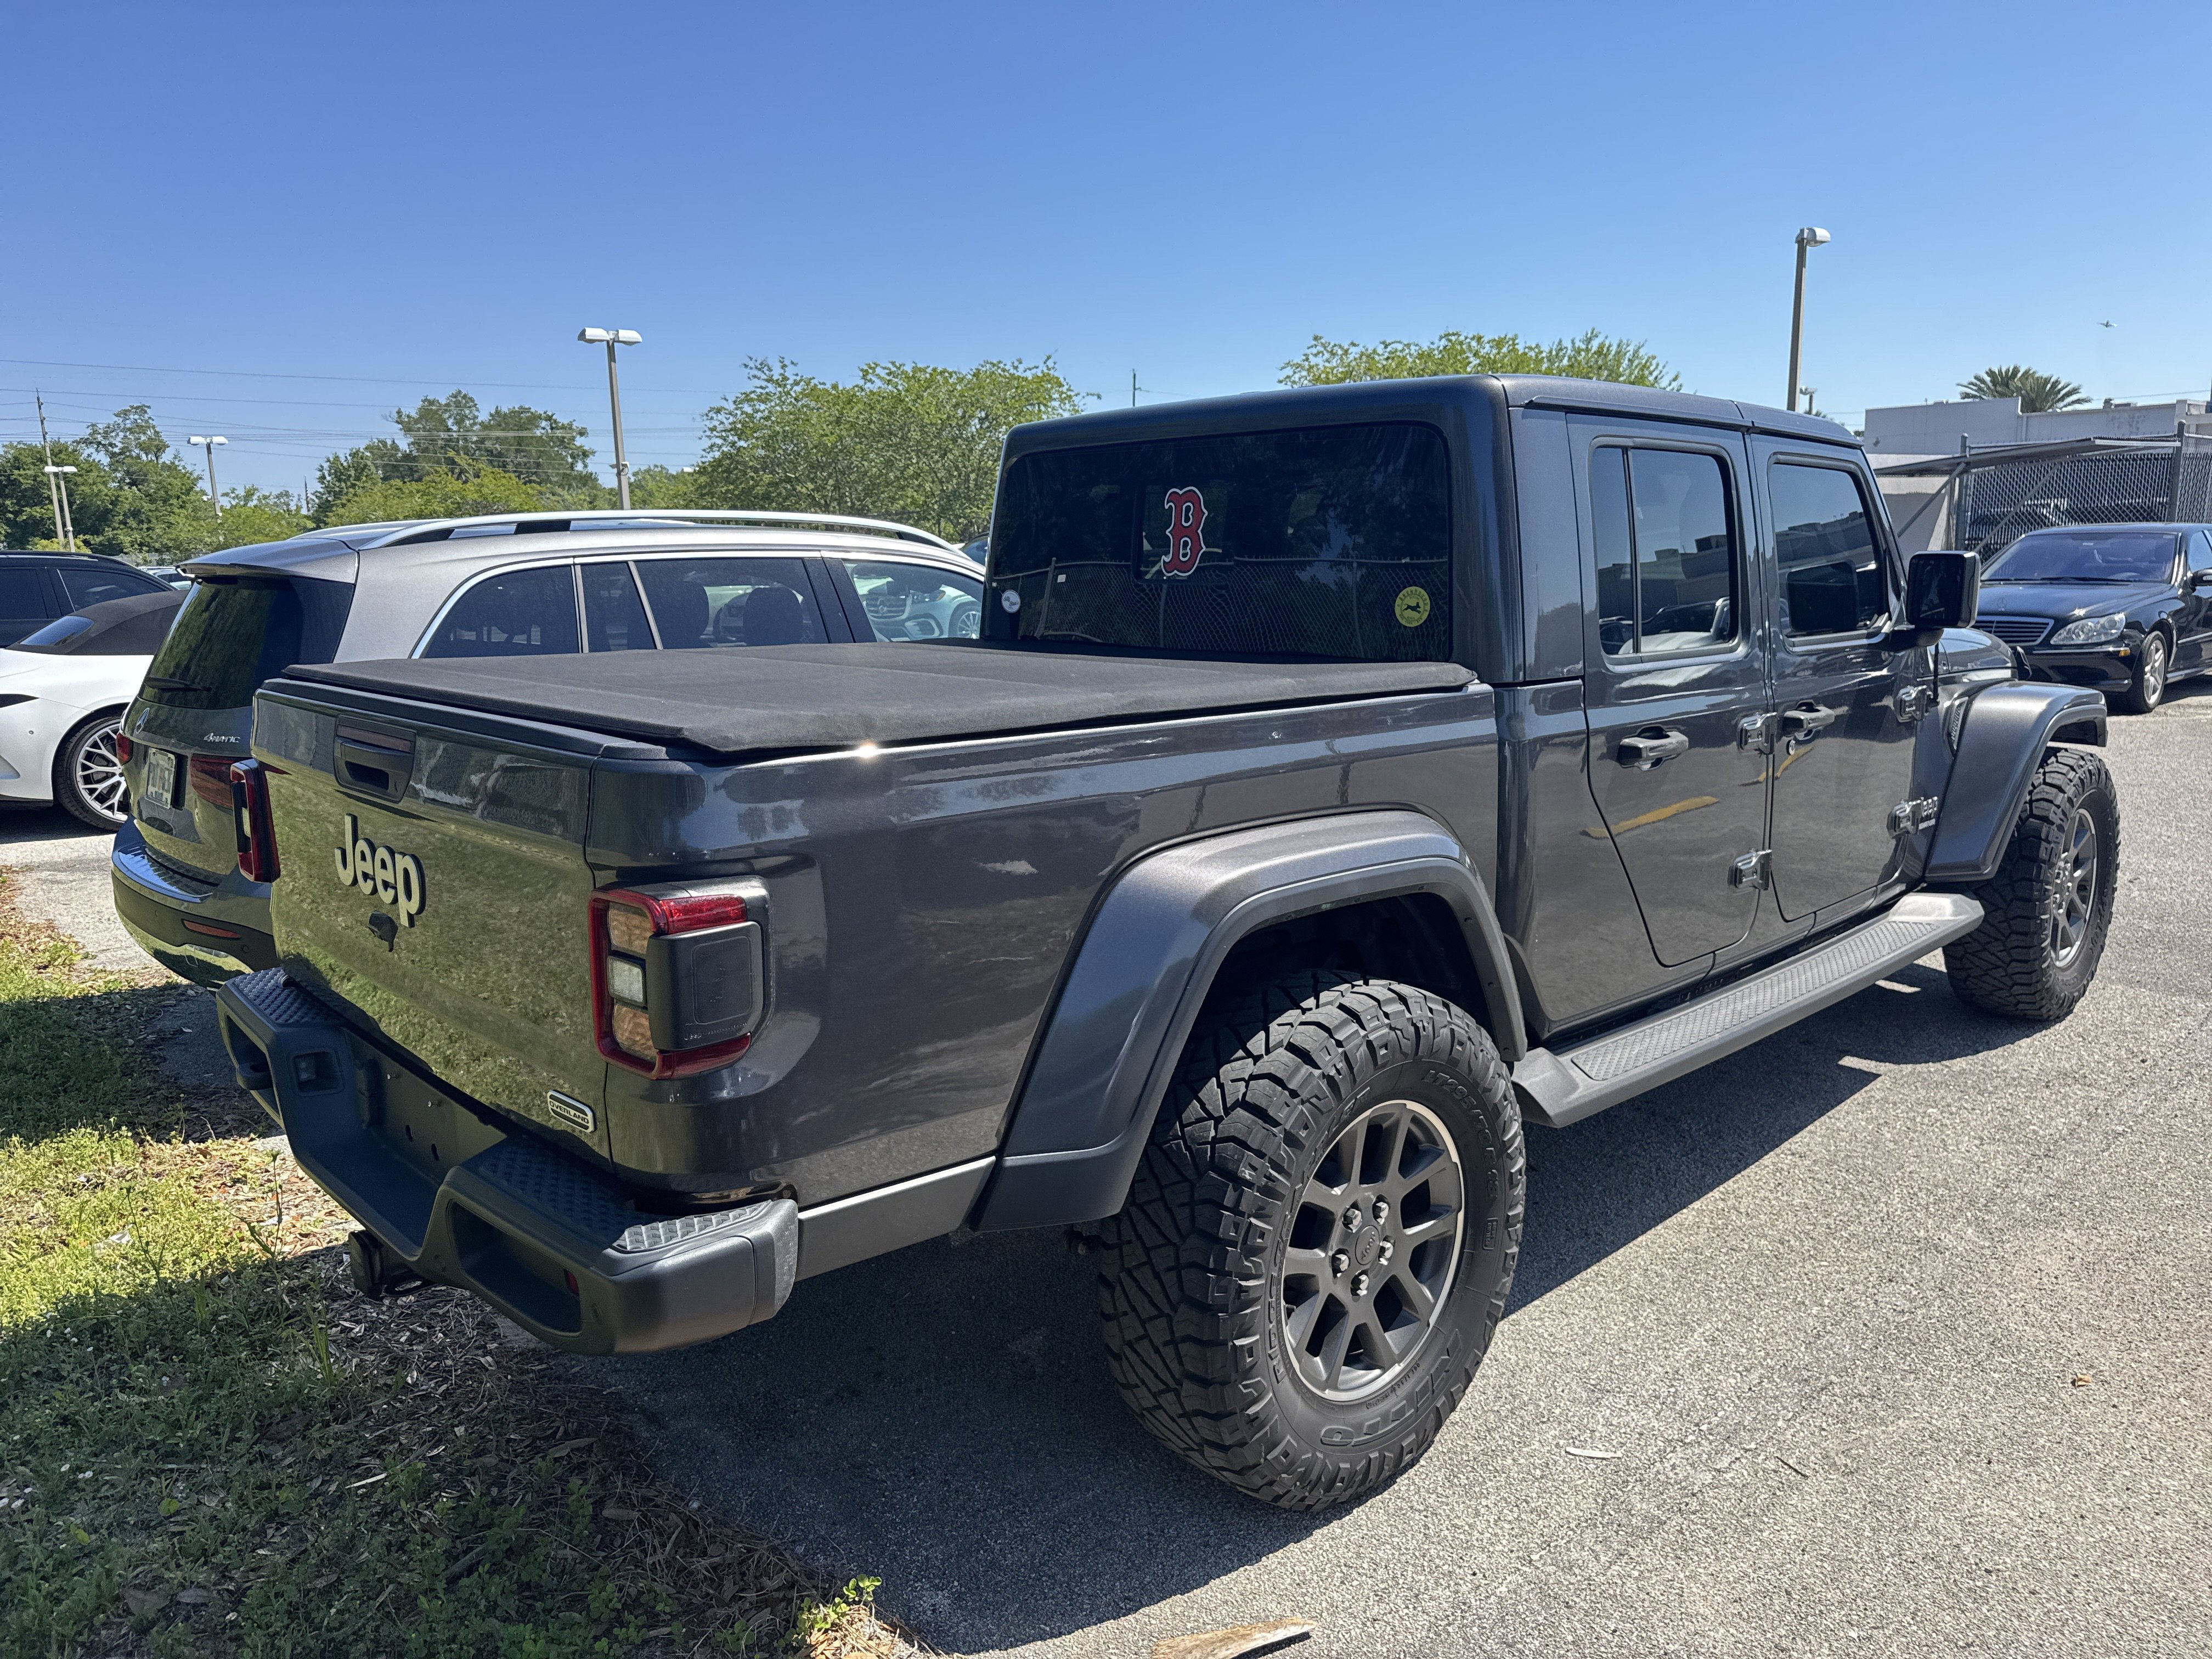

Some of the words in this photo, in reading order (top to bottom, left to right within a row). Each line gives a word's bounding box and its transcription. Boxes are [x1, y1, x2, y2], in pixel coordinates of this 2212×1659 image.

[1161, 486, 1208, 576] B
[335, 813, 426, 928] Jeep
[549, 1100, 590, 1124] OVERLAND
